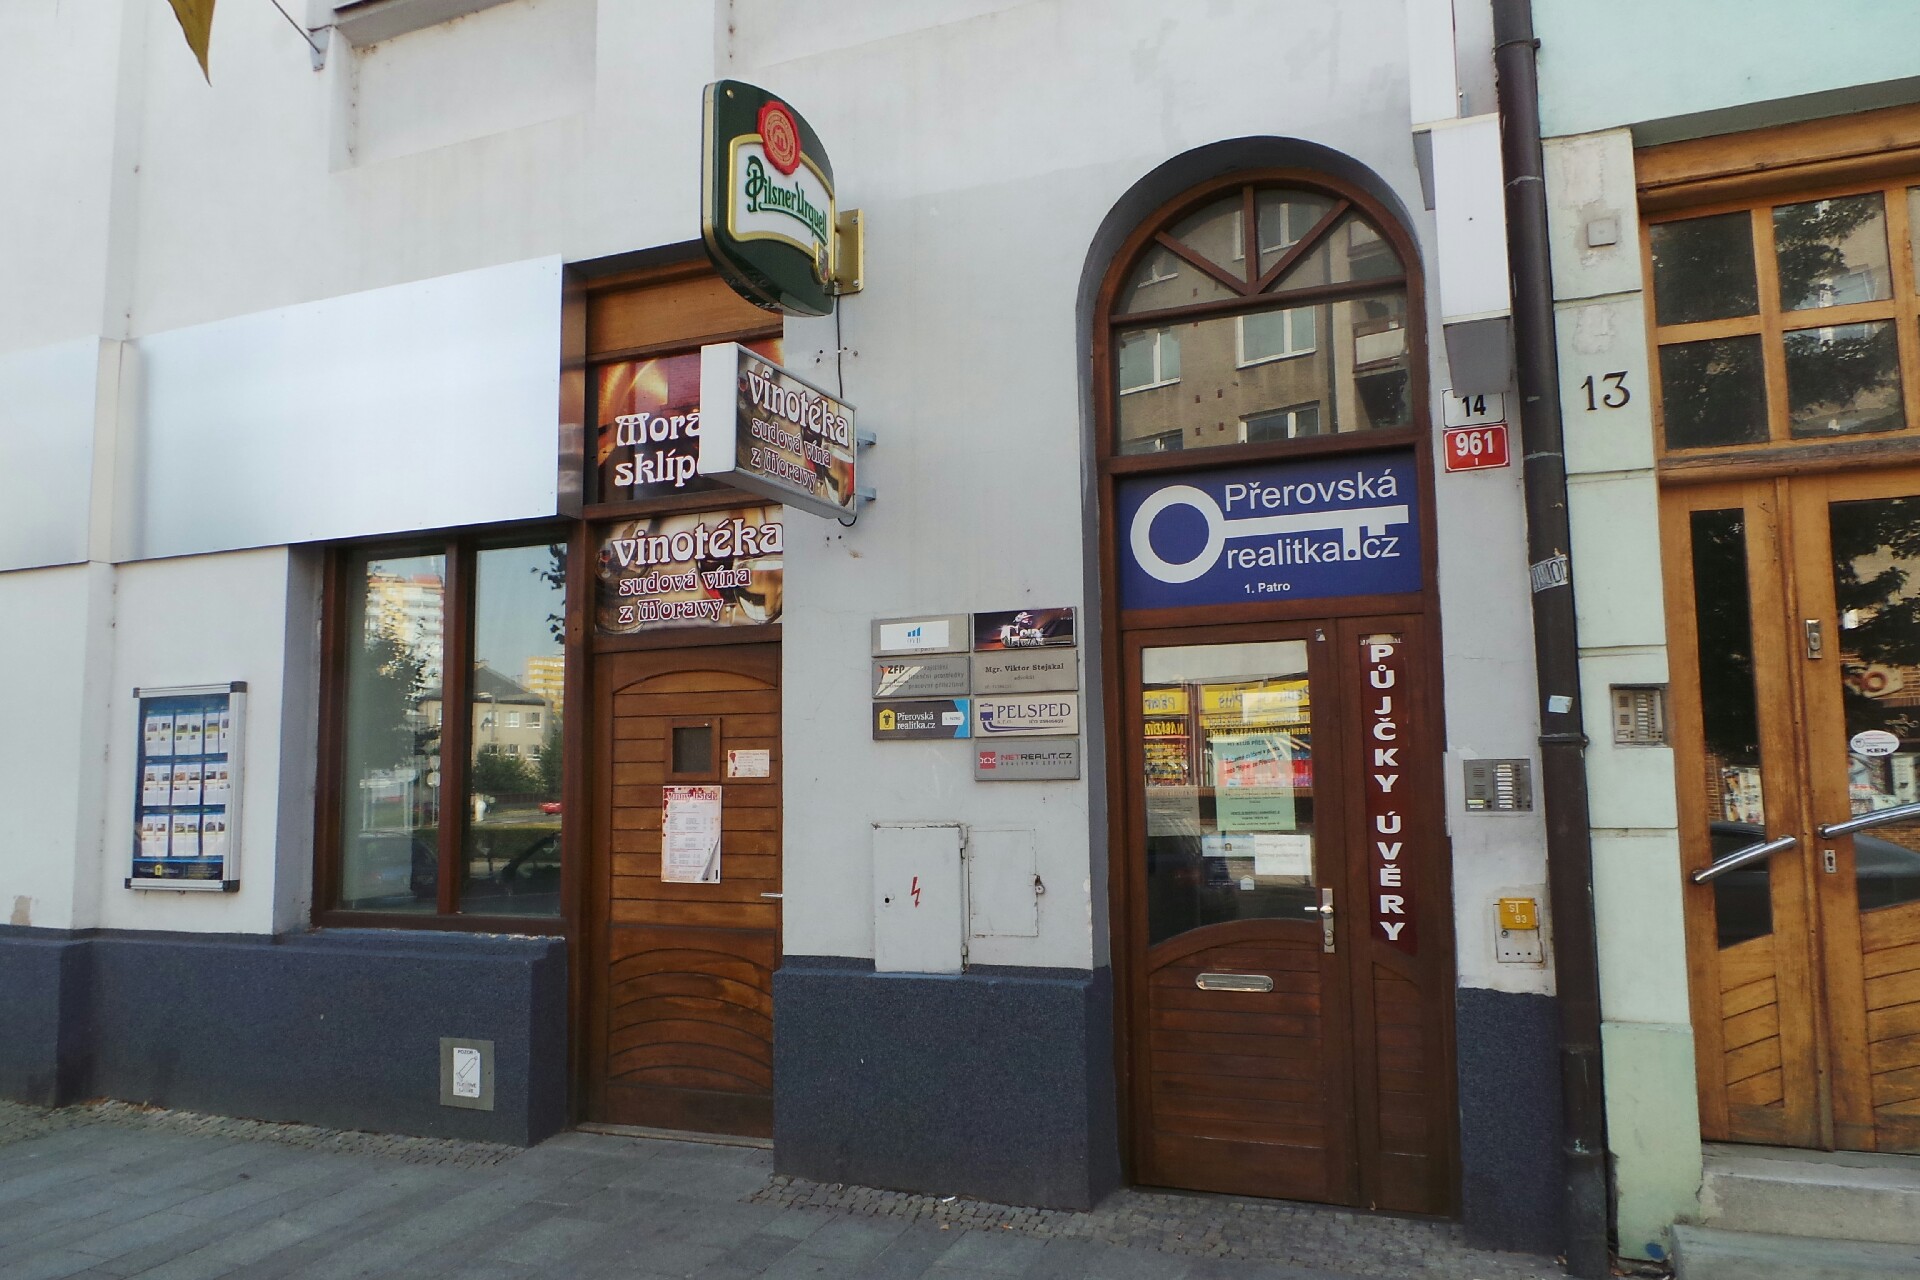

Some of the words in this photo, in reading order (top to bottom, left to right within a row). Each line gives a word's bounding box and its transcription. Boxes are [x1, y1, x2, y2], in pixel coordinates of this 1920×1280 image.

[745, 155, 798, 212] Pilsner
[795, 181, 828, 240] Urquell
[1461, 394, 1487, 418] 14
[1581, 370, 1631, 411] 13
[748, 371, 849, 447] vinotéka
[752, 418, 802, 456] sudová
[804, 440, 832, 468] vína
[1455, 431, 1494, 457] 961
[614, 449, 701, 488] sklíp
[751, 448, 762, 468] z
[764, 449, 817, 494] Moravy
[1224, 469, 1398, 511] Přerovská
[612, 518, 783, 567] vinotéka
[1227, 535, 1401, 569] realitka.cz
[619, 570, 698, 596] sudová
[702, 565, 752, 590] vína
[1244, 584, 1255, 594] 1.
[1257, 582, 1291, 593] Patro
[618, 604, 633, 623] z
[638, 597, 724, 622] Moravy
[888, 665, 905, 674] ZFP
[985, 666, 1002, 674] Mgr.
[896, 711, 934, 721] Přerovská
[896, 721, 936, 730] realitka.cz
[997, 703, 1071, 719] PELSPED
[1369, 644, 1400, 793] PŮJČKY
[1000, 752, 1072, 761] NETREALIT.CZ
[1376, 811, 1406, 941] ÚVĚRY
[1514, 914, 1527, 924] 93
